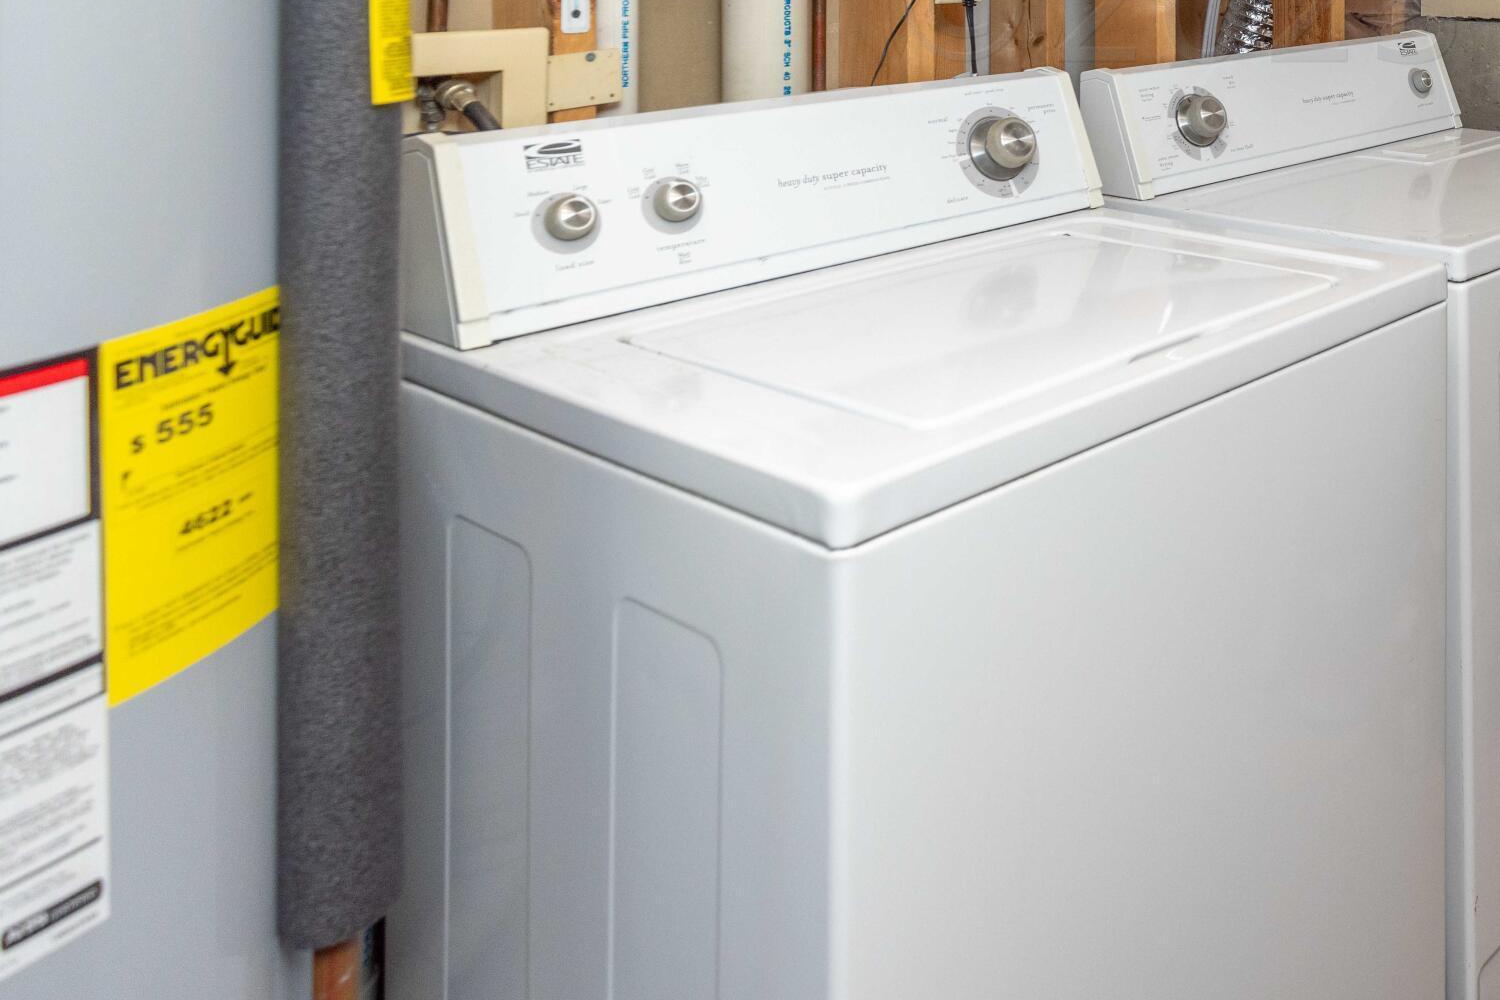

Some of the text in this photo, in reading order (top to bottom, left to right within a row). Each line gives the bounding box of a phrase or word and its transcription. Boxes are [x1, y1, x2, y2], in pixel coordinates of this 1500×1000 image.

[783, 71, 791, 81] 40
[526, 154, 585, 171] ESTATE
[778, 163, 888, 189] heavy duty super capacity
[114, 306, 281, 390] ENERGYGUID
[156, 402, 215, 445] 555
